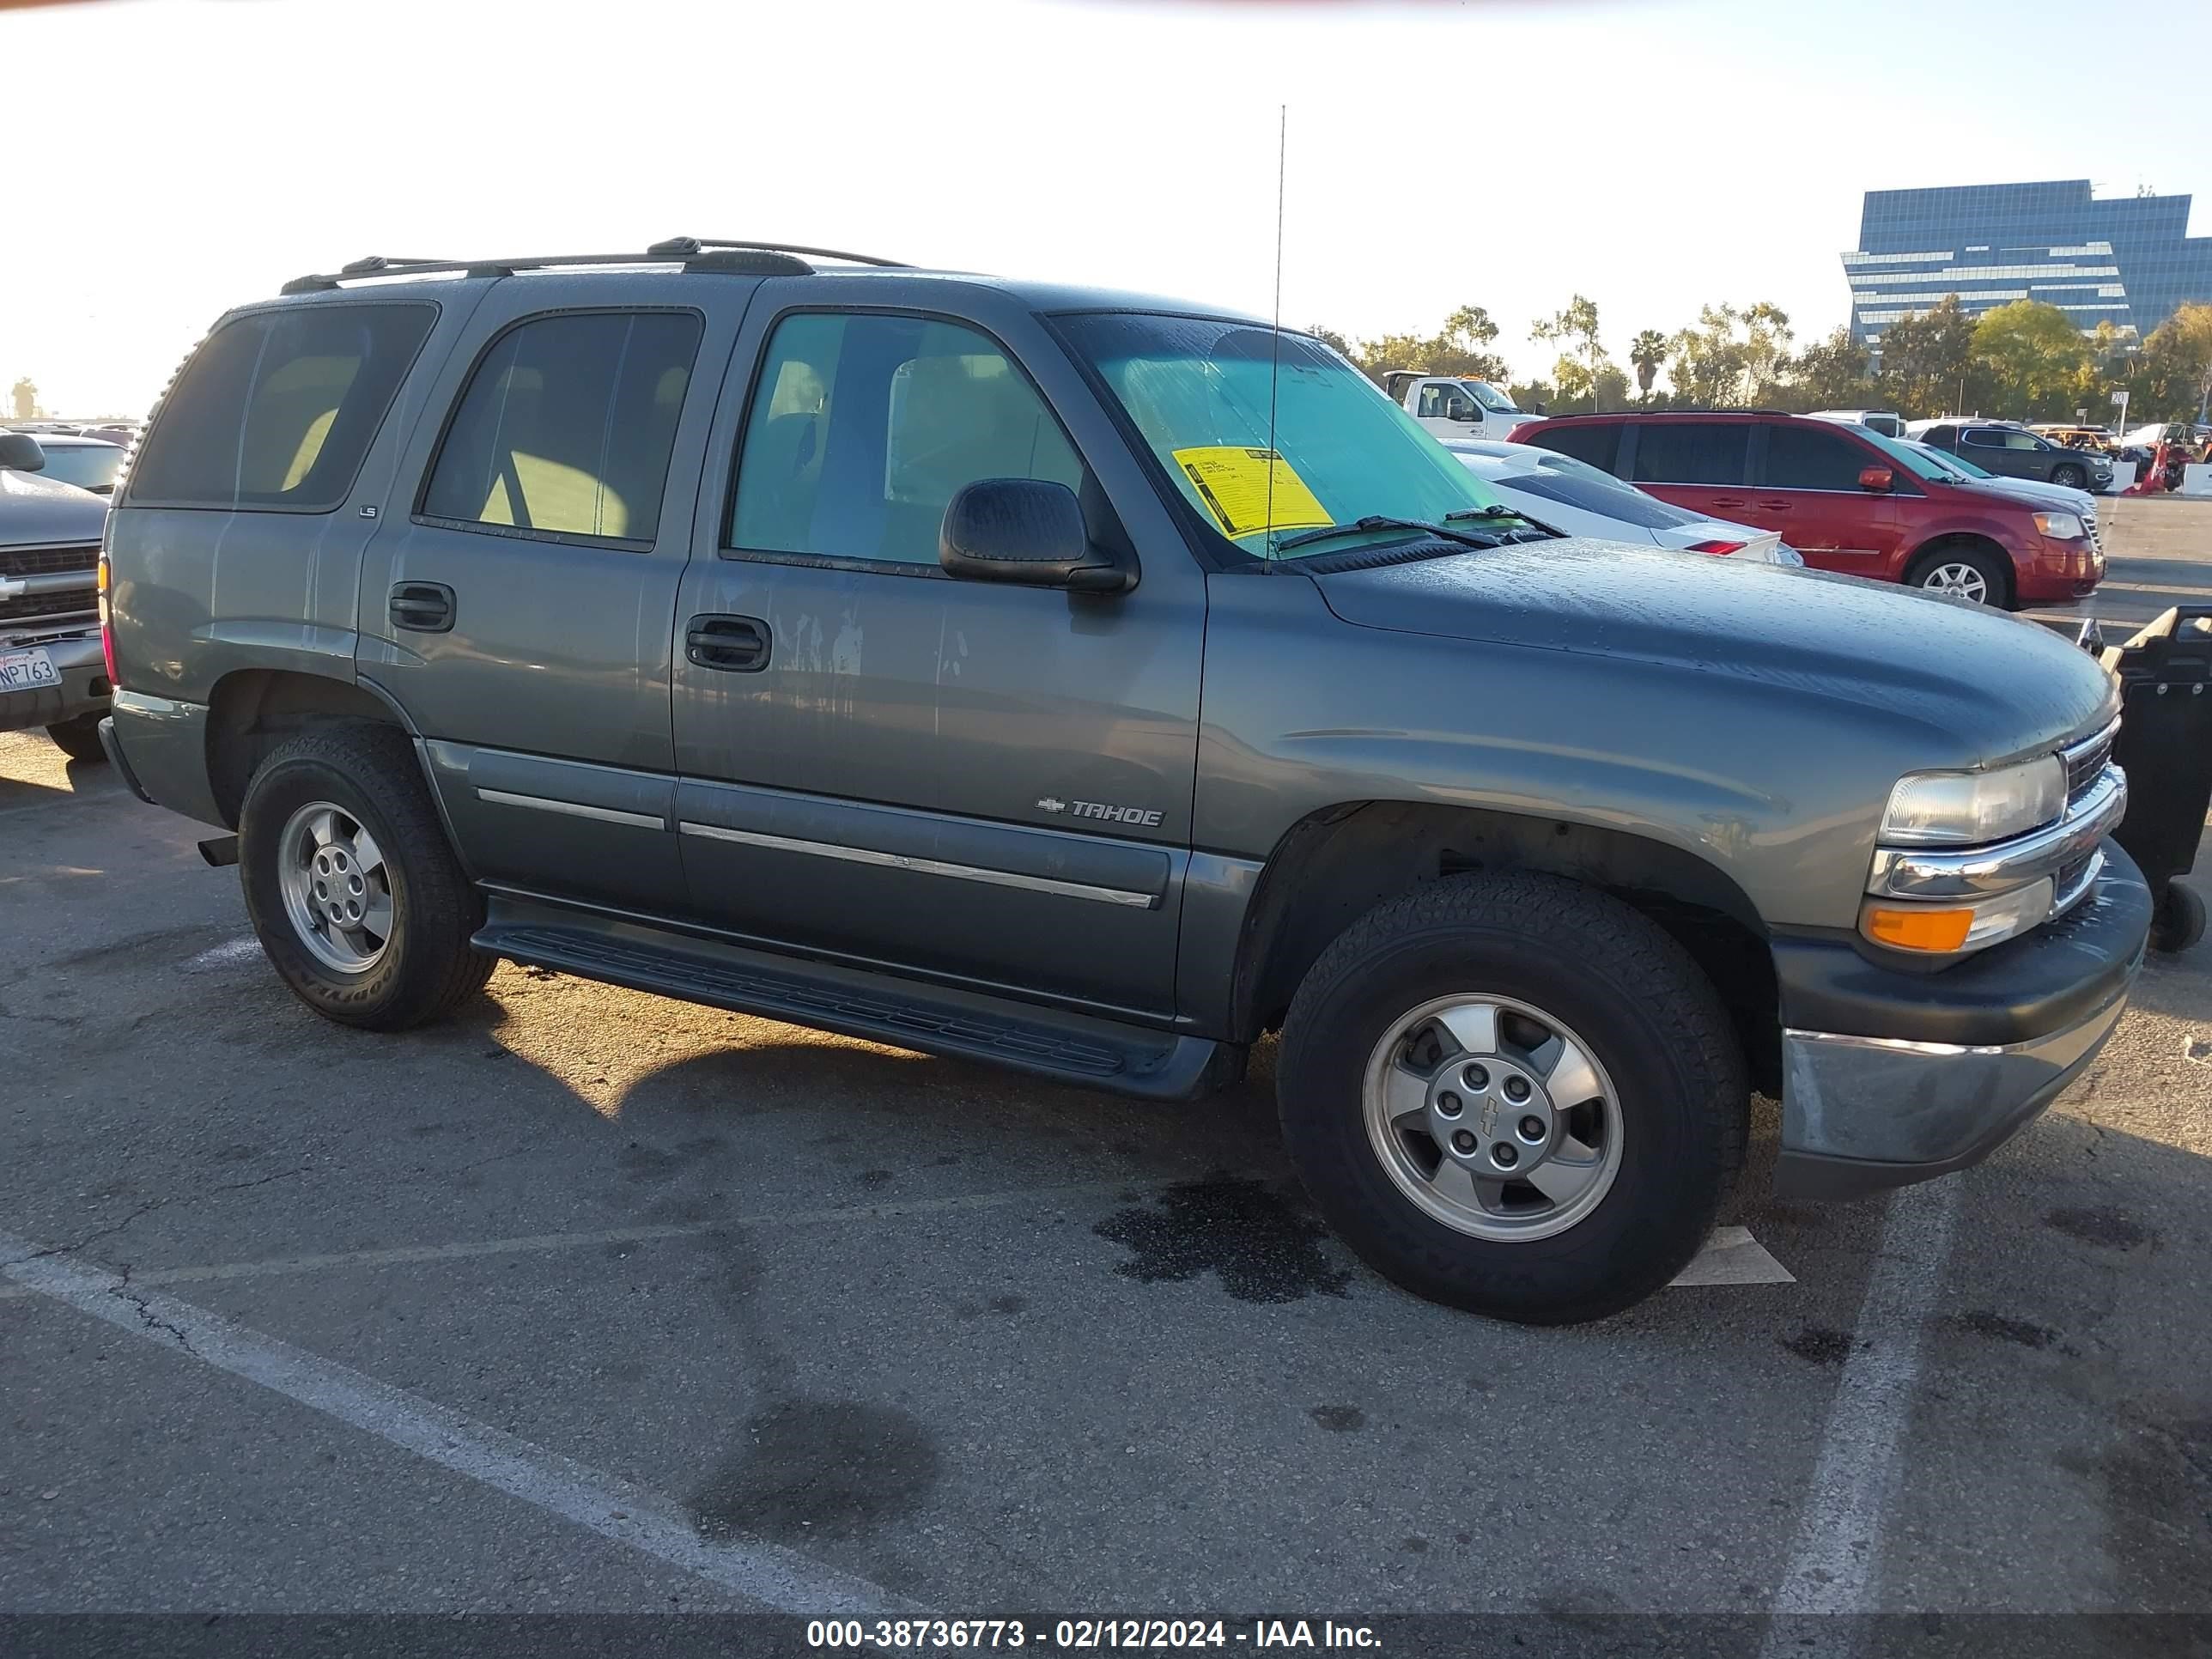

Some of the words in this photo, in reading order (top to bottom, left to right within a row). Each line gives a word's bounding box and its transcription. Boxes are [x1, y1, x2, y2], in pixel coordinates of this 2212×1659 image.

[2112, 392, 2124, 404] 20
[359, 507, 376, 517] LS
[1072, 799, 1164, 827] TAHOE
